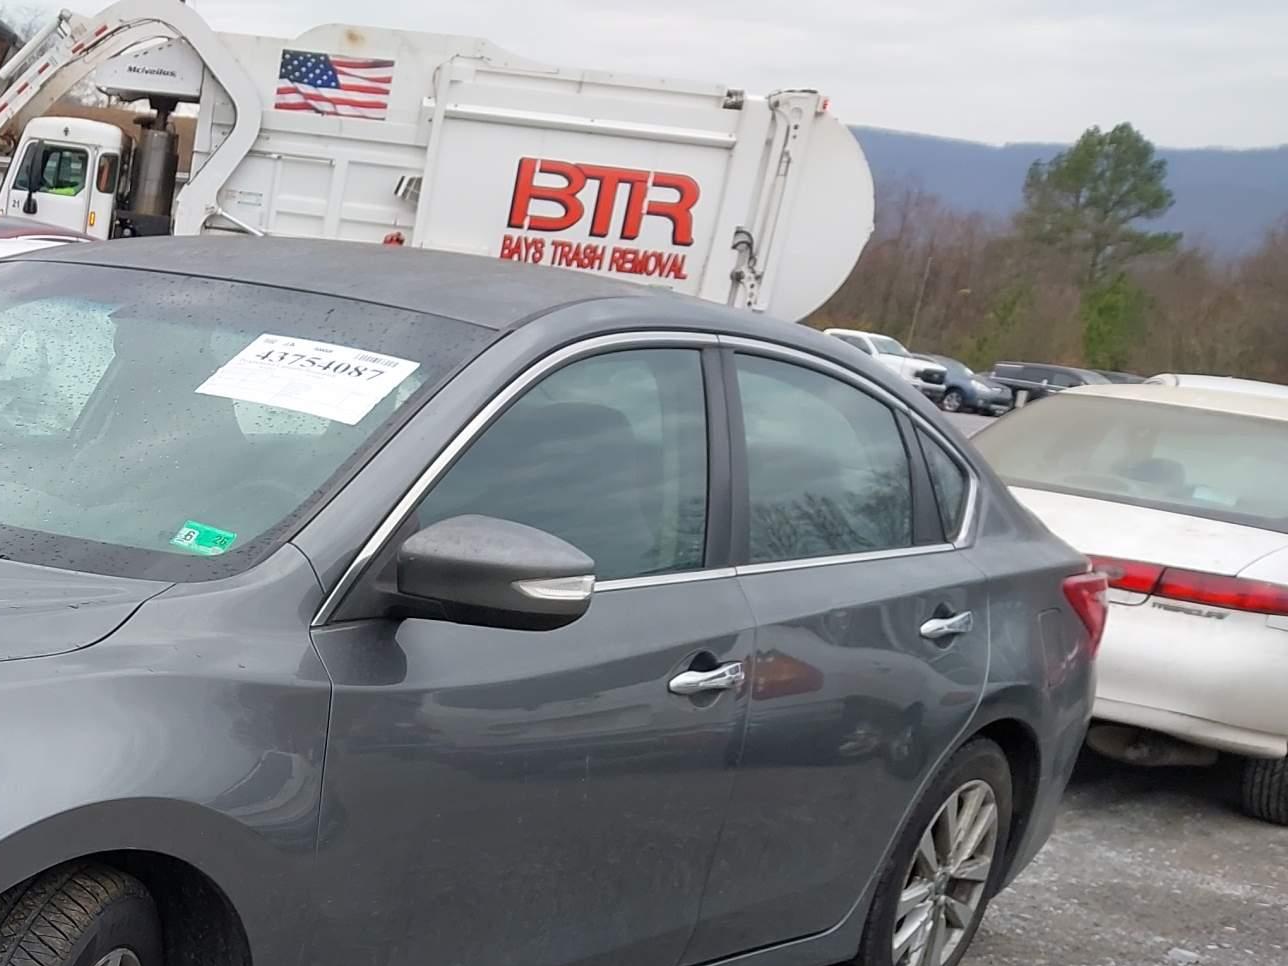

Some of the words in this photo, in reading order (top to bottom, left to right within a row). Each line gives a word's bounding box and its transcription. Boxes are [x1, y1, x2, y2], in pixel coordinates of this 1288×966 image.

[507, 156, 700, 247] BTR
[550, 240, 606, 271] TRASH
[607, 247, 688, 280] REMOVAL
[255, 349, 385, 382] 43754087
